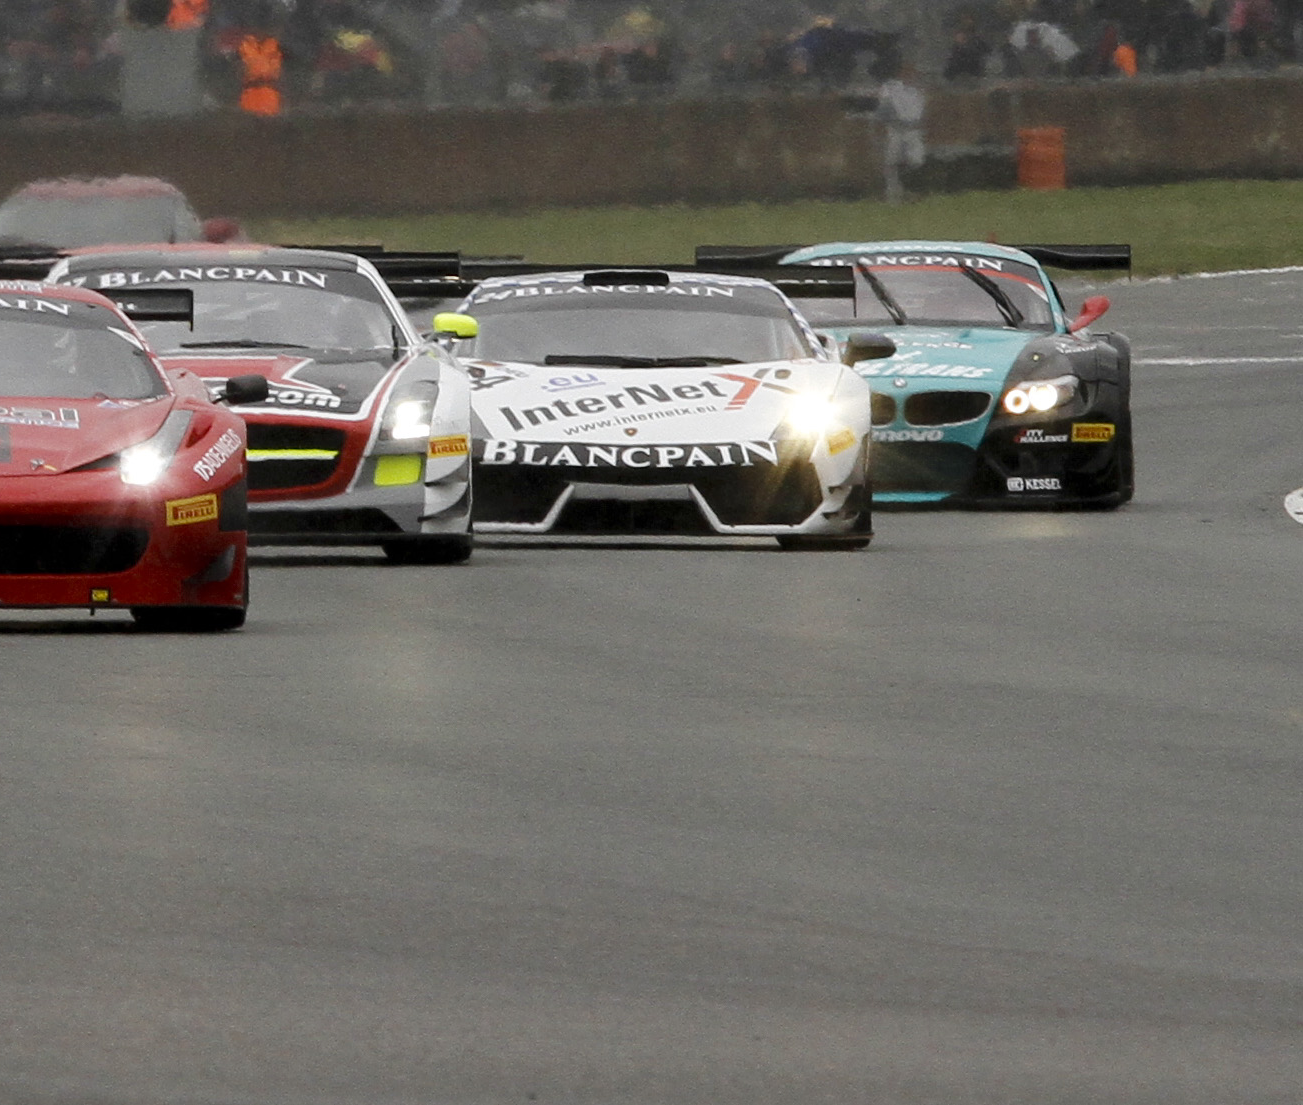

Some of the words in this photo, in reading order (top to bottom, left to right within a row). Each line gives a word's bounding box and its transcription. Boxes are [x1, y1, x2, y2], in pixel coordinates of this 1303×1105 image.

[99, 266, 329, 289] BLANCPAIN
[512, 284, 734, 297] BLANCPAIN
[563, 403, 718, 437] www.internetx.eu
[431, 437, 468, 455] PIRELLI
[480, 438, 779, 467] BLANCPAIN
[1025, 479, 1062, 490] KESSEL
[172, 500, 215, 520] PIRELLI
